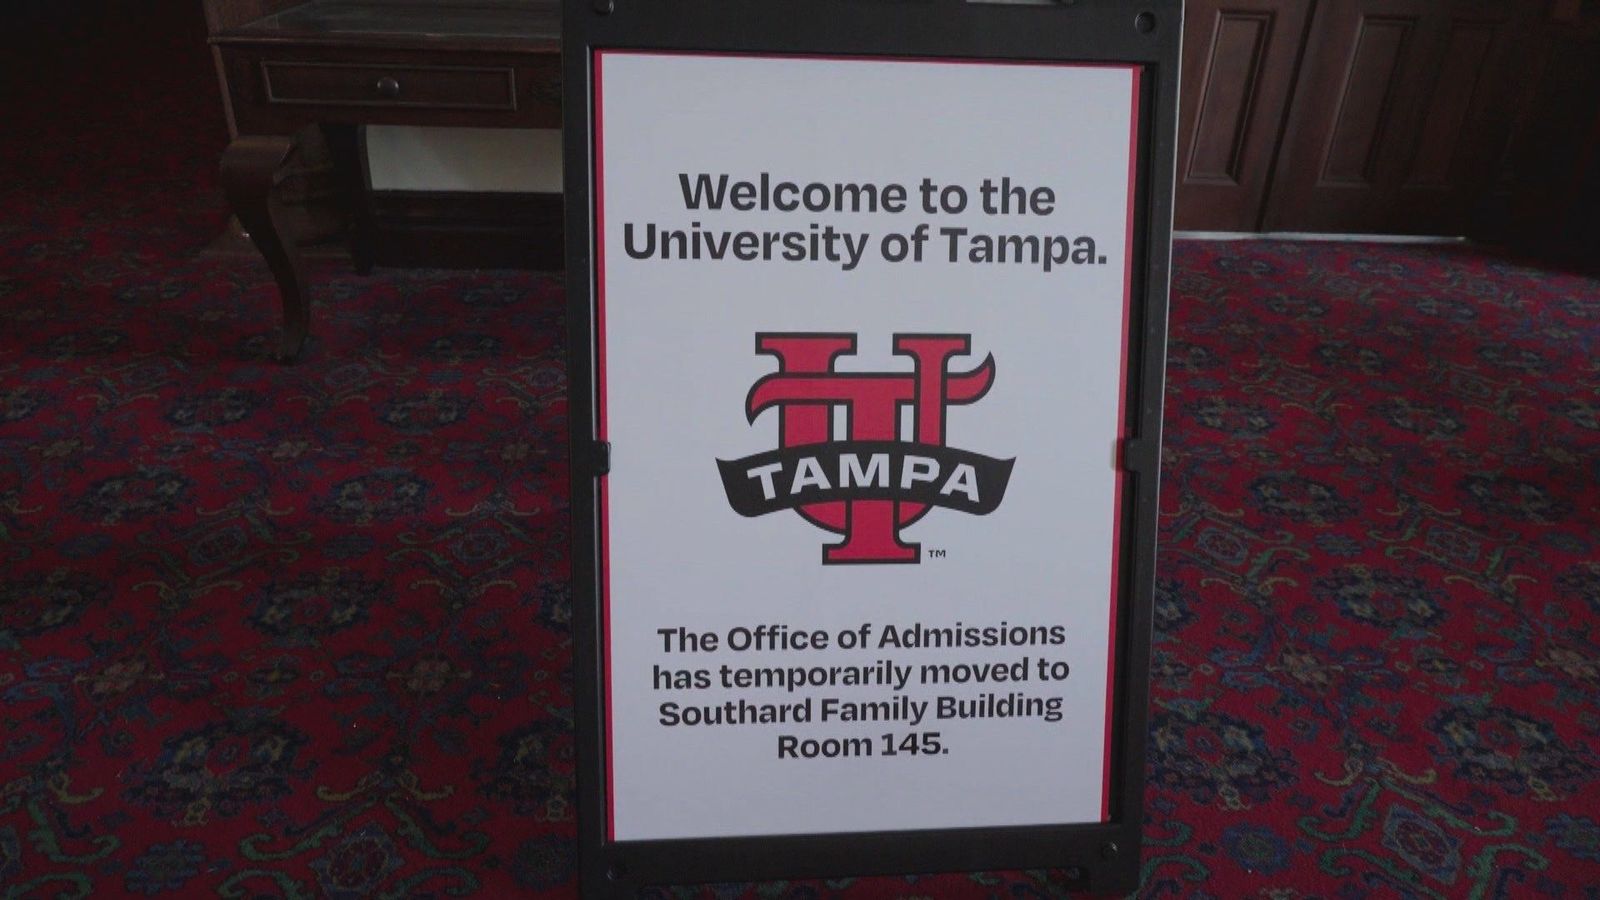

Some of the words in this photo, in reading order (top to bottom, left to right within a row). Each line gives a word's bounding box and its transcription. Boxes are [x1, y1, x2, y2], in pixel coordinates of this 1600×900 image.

[679, 172, 907, 213] Welcome
[919, 177, 968, 215] to
[979, 176, 1056, 216] the
[624, 222, 869, 271] University
[880, 223, 929, 263] of
[940, 227, 1108, 273] Tampa.
[746, 453, 980, 503] TAMPA
[657, 627, 719, 653] The
[727, 624, 829, 652] Office
[837, 623, 872, 650] of
[878, 621, 1066, 649] Admissions
[653, 664, 712, 690] has
[719, 659, 912, 692] temporarily
[920, 656, 1029, 685] moved
[1036, 657, 1070, 682] to
[658, 698, 813, 727] Southard
[820, 695, 929, 726] Family
[936, 692, 1064, 723] Building
[777, 733, 873, 759] Room
[881, 731, 949, 757] 145.
